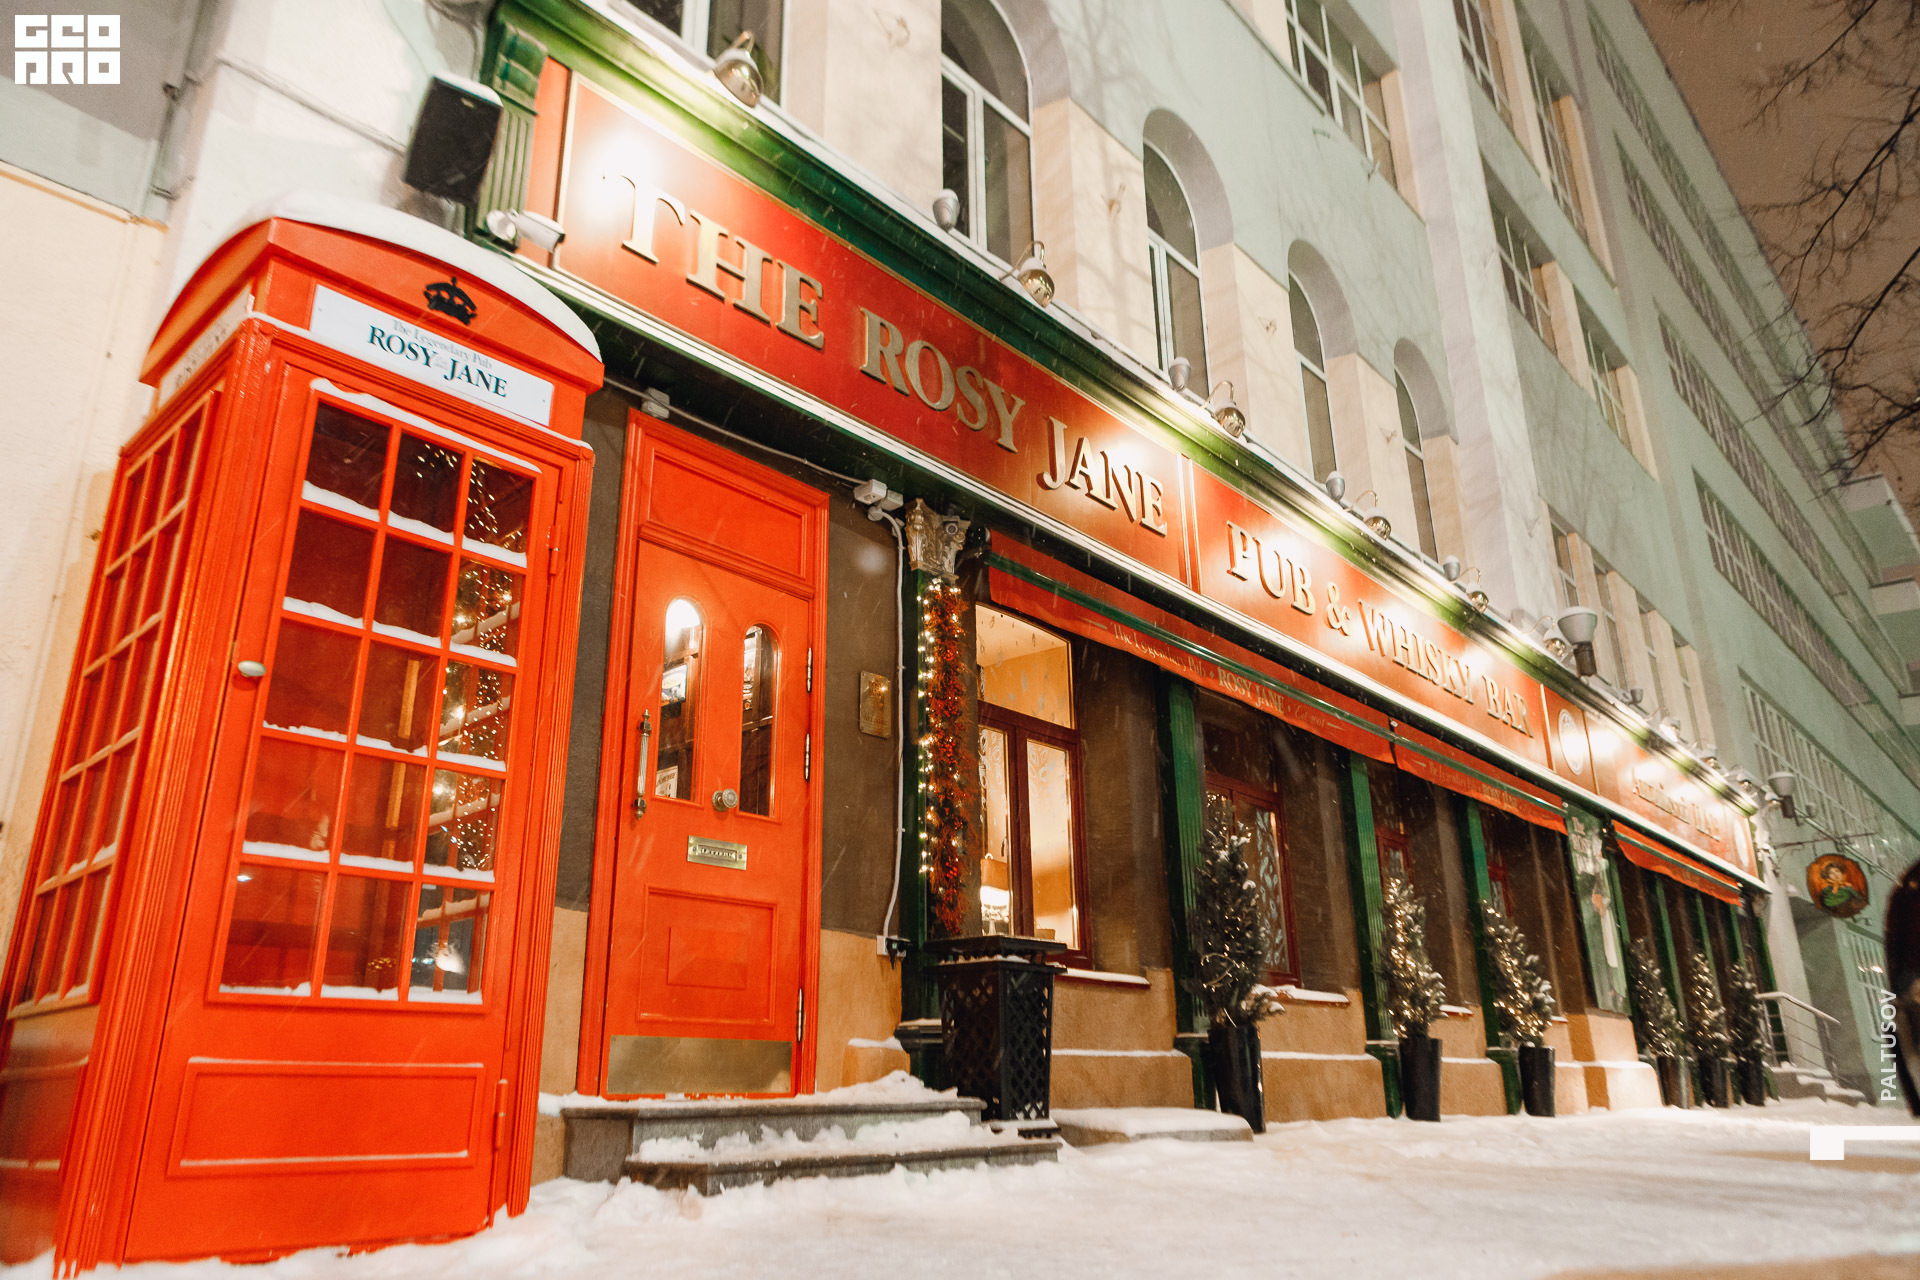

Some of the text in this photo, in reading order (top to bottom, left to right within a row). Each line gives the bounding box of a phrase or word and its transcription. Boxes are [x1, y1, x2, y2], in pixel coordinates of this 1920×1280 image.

[367, 324, 508, 398] ROSY JANE
[602, 172, 1167, 538] THE ROSY JANE
[1217, 666, 1251, 698] ROSY
[1255, 685, 1285, 715] JANE
[1226, 520, 1534, 738] PUB & WHISKY BAR
